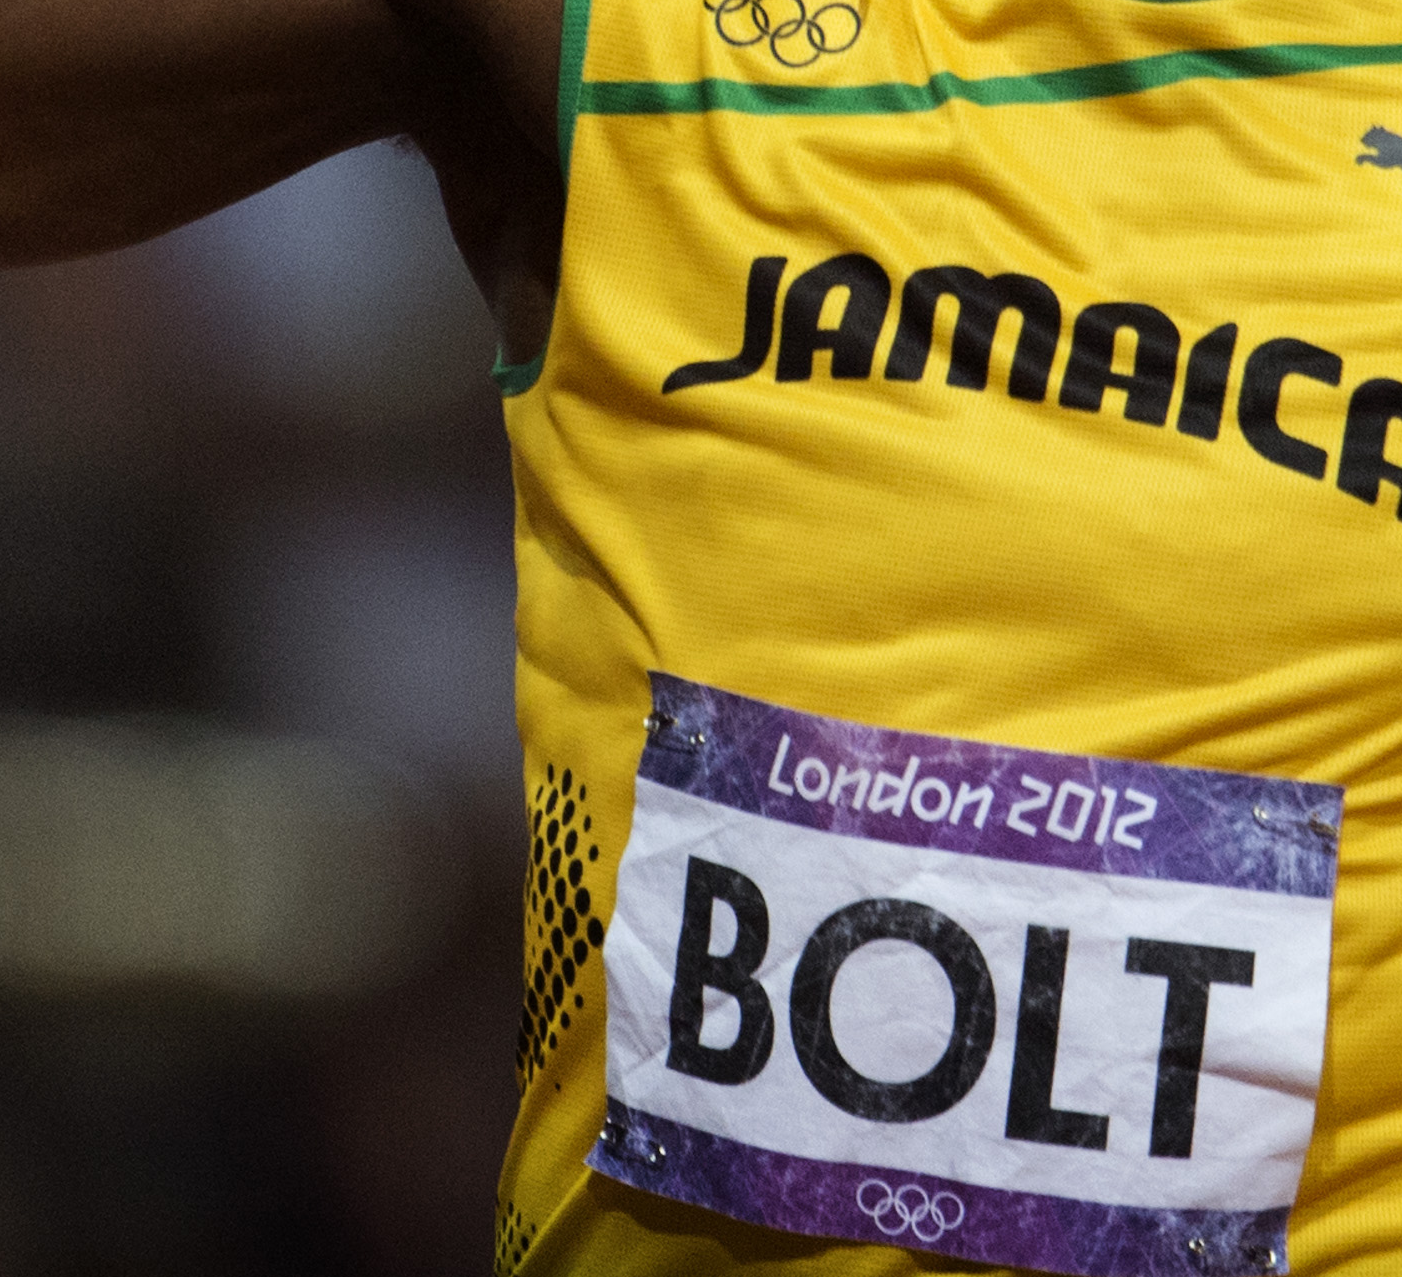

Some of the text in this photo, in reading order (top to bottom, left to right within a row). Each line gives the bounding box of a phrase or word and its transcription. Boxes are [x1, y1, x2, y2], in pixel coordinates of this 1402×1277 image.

[767, 734, 1157, 851] London 2012
[665, 855, 1256, 1159] BOLT
